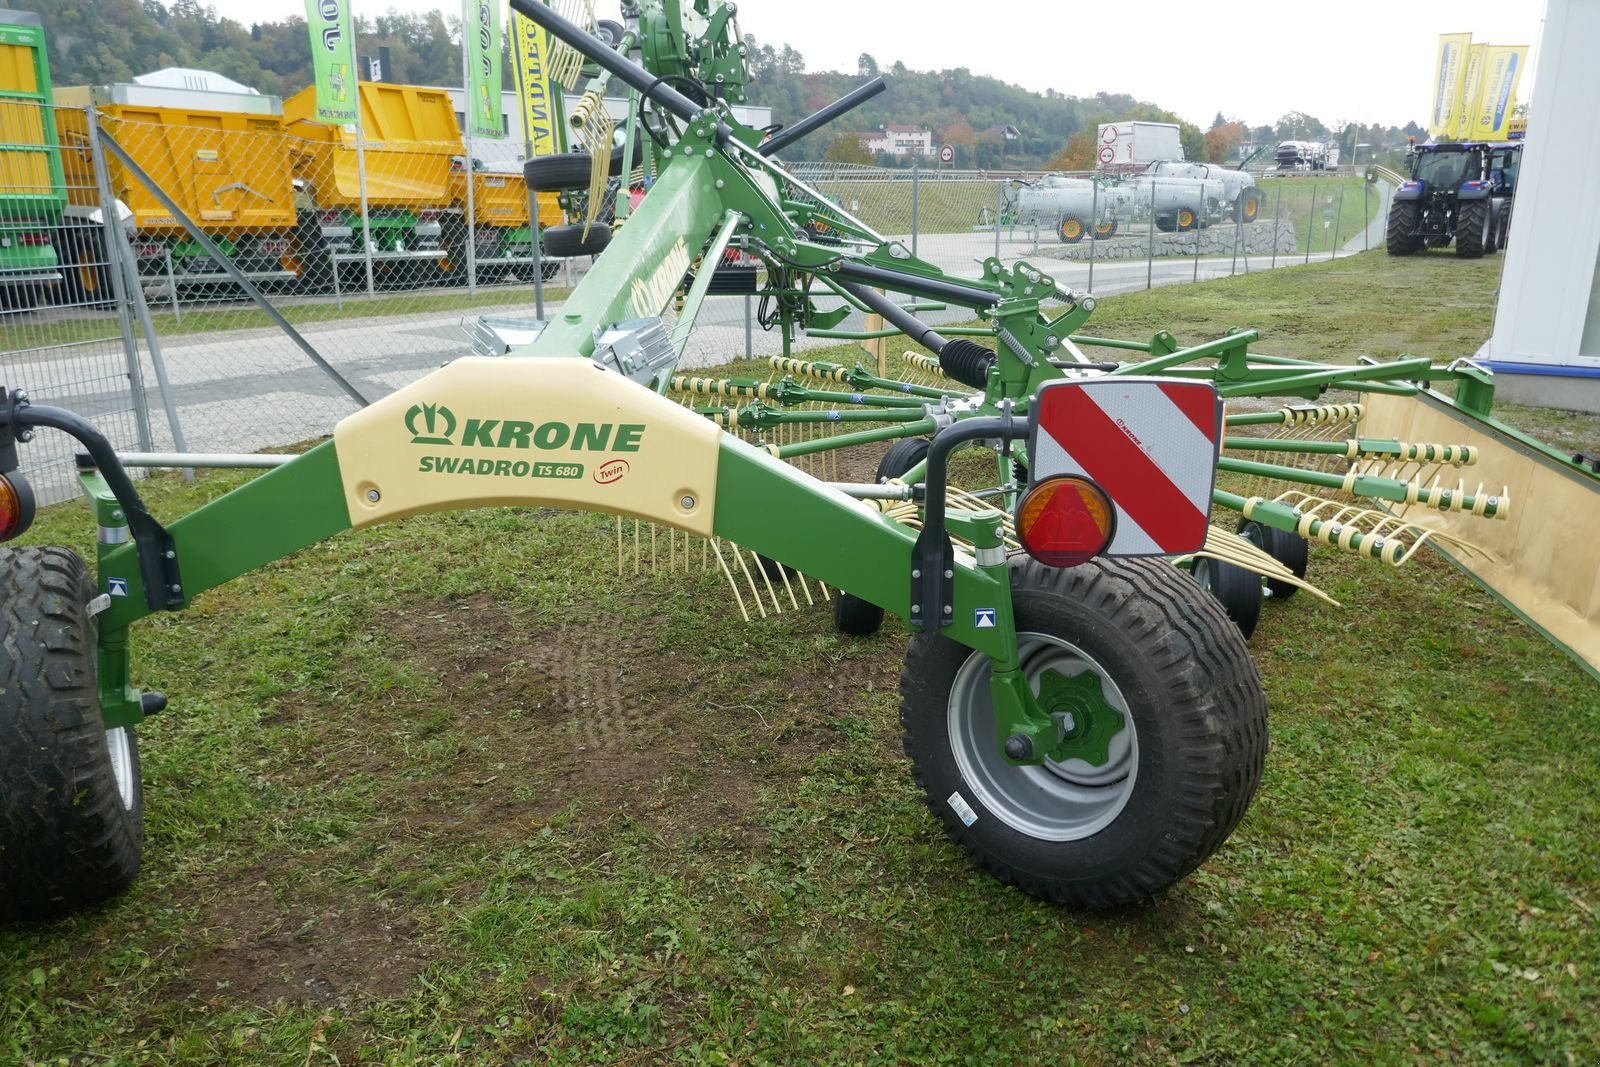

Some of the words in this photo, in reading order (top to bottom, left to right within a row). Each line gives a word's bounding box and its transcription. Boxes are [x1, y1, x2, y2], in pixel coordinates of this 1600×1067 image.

[460, 418, 647, 453] KRONE
[418, 455, 531, 478] SWADRO
[537, 464, 553, 476] TS
[555, 465, 578, 477] 680
[599, 464, 624, 480] Twin
